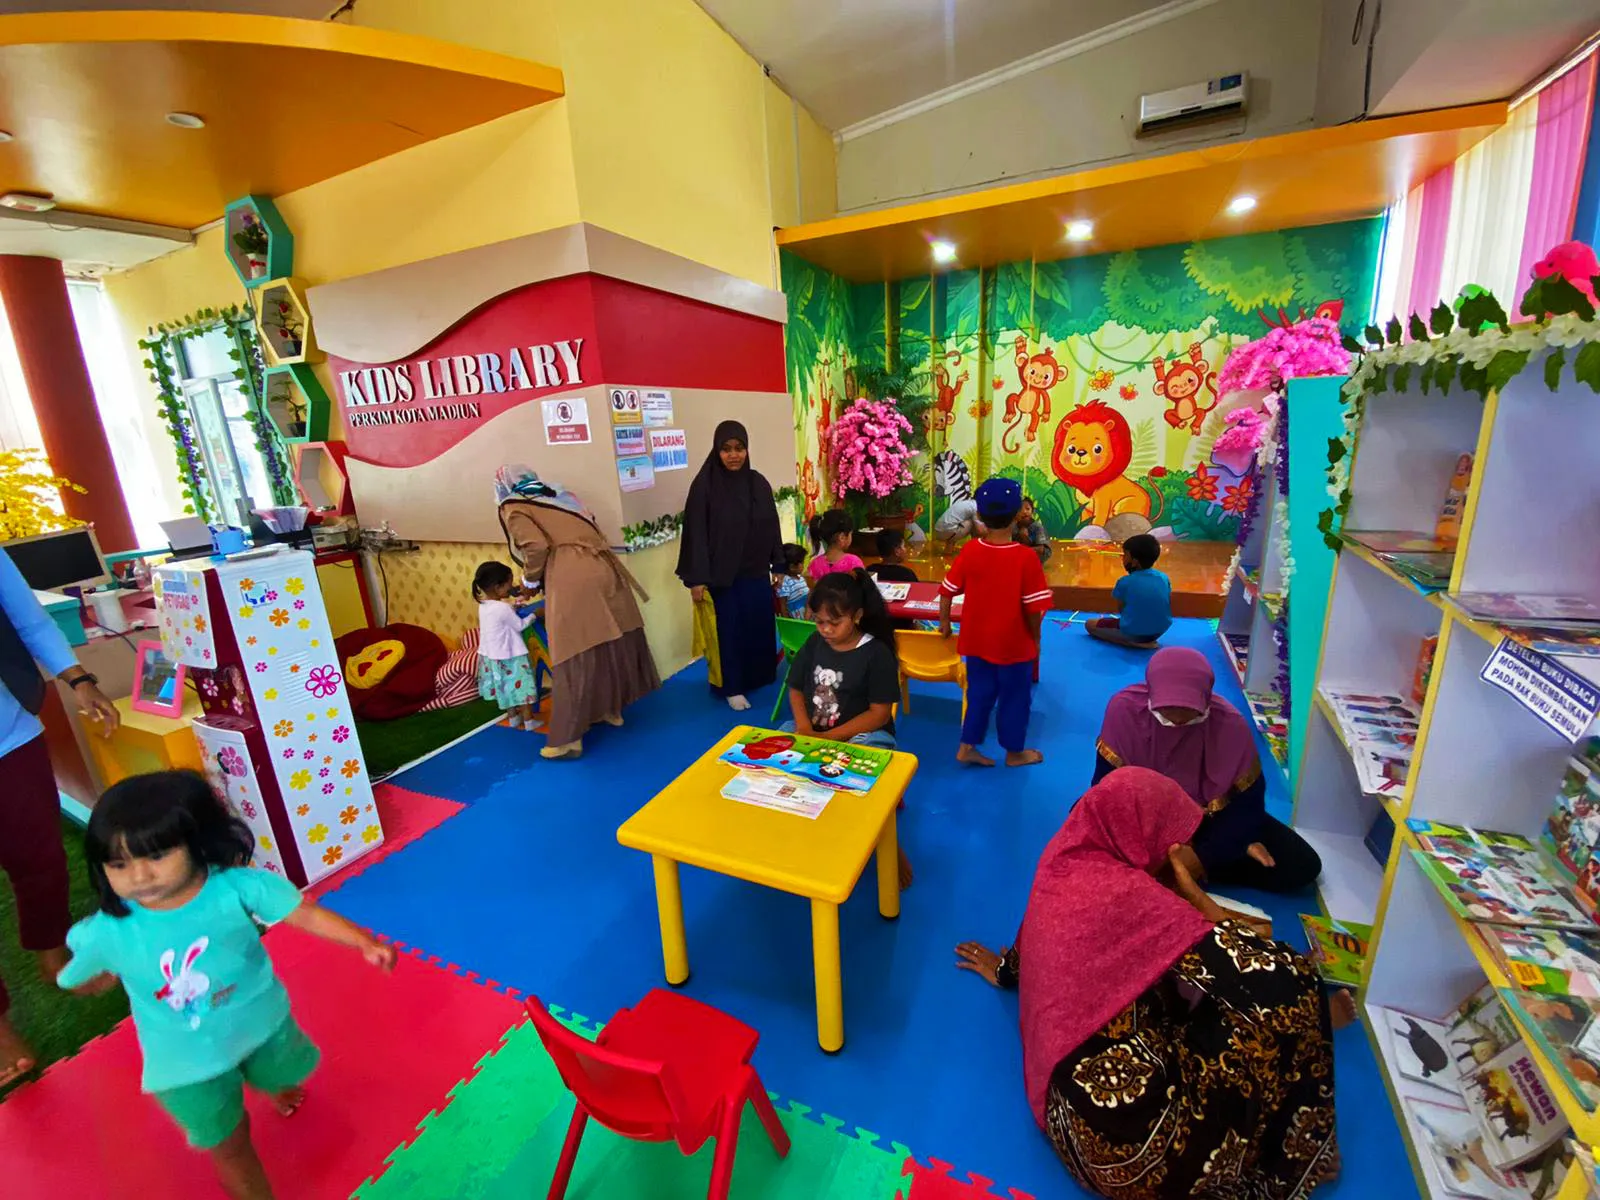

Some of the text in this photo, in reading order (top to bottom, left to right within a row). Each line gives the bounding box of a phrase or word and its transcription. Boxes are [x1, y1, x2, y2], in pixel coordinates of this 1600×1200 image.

[339, 338, 584, 407] KIDS LIBRARY
[350, 402, 481, 428] PERKIM KOTA MADIUN
[652, 435, 685, 448] DILARANG
[1491, 667, 1515, 687] PADA
[1514, 681, 1531, 698] RAK
[1528, 692, 1552, 713] BUKU
[1498, 655, 1589, 724] MOHON DIKEMBALIKAN
[1506, 641, 1596, 707] SETELAH BUKU DIBACA
